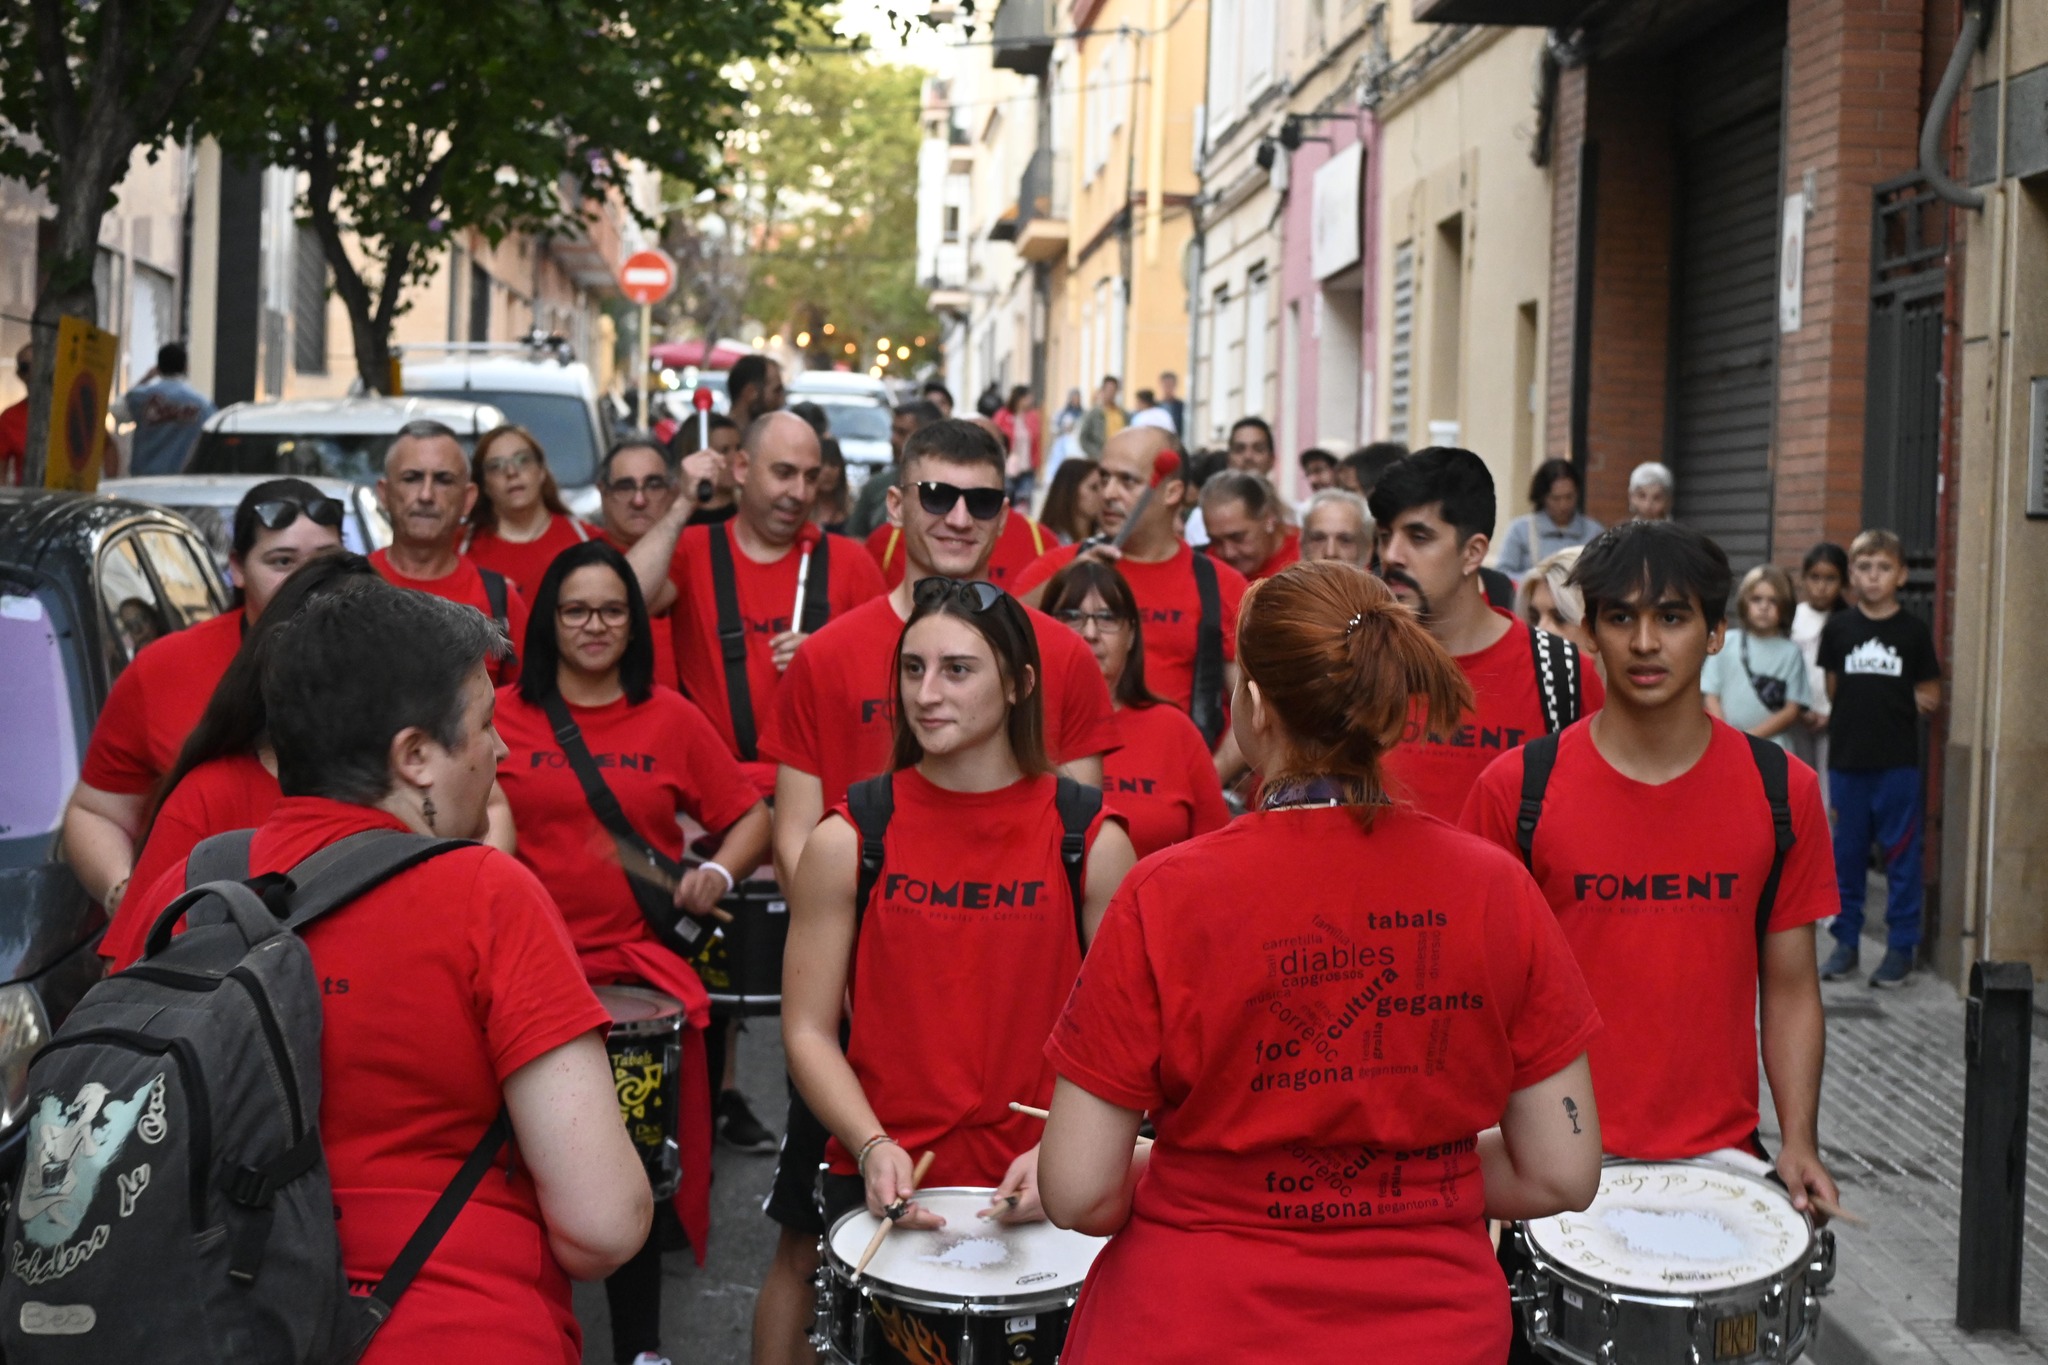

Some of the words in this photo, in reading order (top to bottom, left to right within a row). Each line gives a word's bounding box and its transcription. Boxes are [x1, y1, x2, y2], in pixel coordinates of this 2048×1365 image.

[530, 751, 656, 773] FOENT
[885, 874, 1045, 909] FOMENT
[1573, 872, 1739, 900] FOMENT
[1368, 909, 1447, 930] tabals
[1262, 934, 1323, 951] carretilla
[1280, 943, 1396, 976] diables
[1281, 969, 1365, 989] capgrossos
[1327, 967, 1398, 1040] cultura
[1375, 991, 1484, 1018] gegants
[1269, 1000, 1339, 1063] correfoc
[1373, 1022, 1383, 1060] gralla
[1256, 1038, 1301, 1064] foc
[1251, 1065, 1354, 1092] dragona
[1265, 1172, 1315, 1193] foc
[1267, 1201, 1372, 1222] dragona
[1377, 1198, 1439, 1215] gegantona
